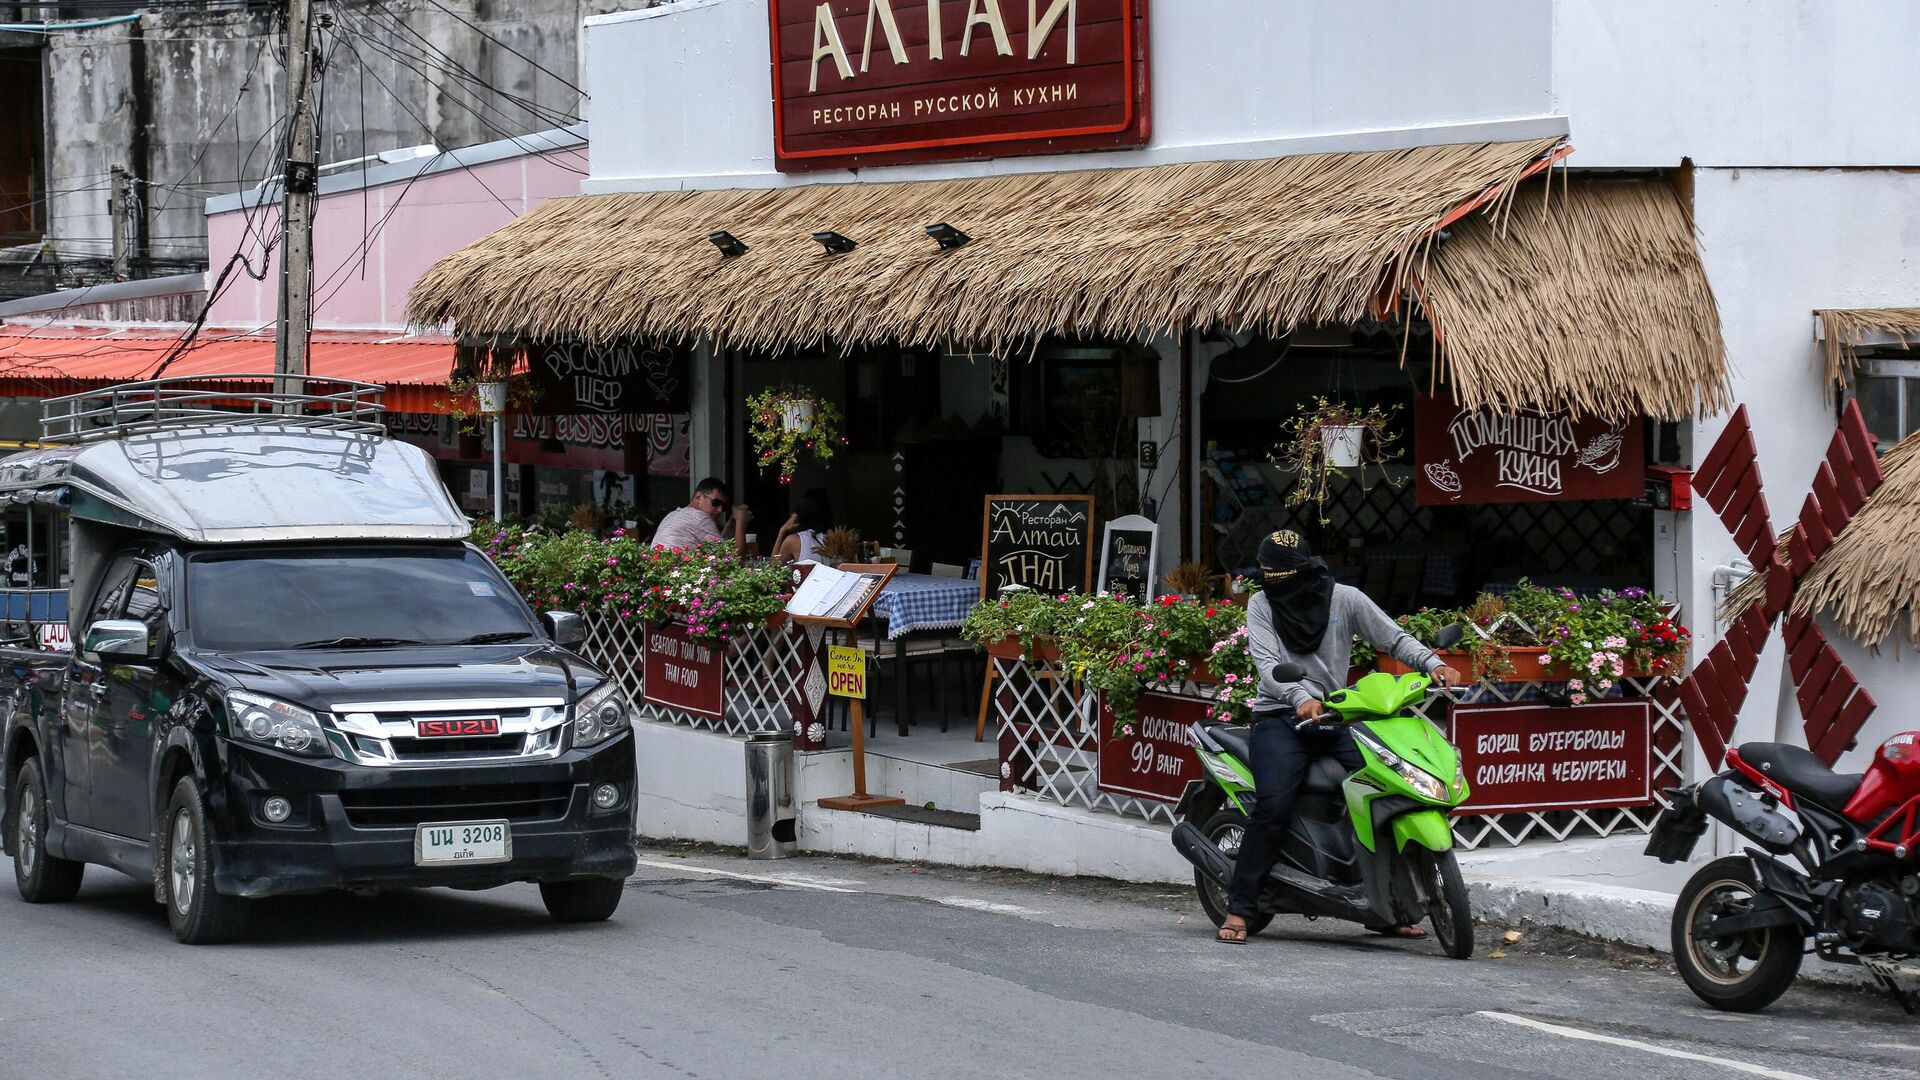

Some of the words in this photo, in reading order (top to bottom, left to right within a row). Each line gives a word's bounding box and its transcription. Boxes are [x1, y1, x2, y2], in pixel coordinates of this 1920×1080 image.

[813, 103, 901, 125] РЕСТОРАН
[914, 87, 999, 116] РУССКОЙ
[1013, 83, 1078, 107] КУХНИ
[574, 375, 622, 407] ШЕФ
[1450, 411, 1579, 463] ДОМАШНЯЯ
[1495, 450, 1562, 490] КУХНЯ
[990, 516, 1080, 547] Алтай
[1022, 512, 1068, 528] Ресторан
[999, 555, 1064, 590] THAI
[650, 633, 679, 657] SEAFOOD
[680, 641, 695, 661] TOM
[830, 650, 852, 661] Come
[853, 652, 865, 663] In
[664, 662, 681, 684] THAI
[680, 667, 699, 688] FOOD
[830, 671, 863, 694] OPEN
[419, 719, 499, 736] ISUZU
[1477, 733, 1520, 754] БОРЩ
[1529, 729, 1626, 753] БУТЕРБРОДЫ
[1131, 741, 1154, 774] 99
[1156, 753, 1184, 776] BAHT
[1476, 762, 1546, 785] СОЛЯНКА
[1552, 759, 1627, 782] ЧЕБУРЕКИ
[430, 829, 453, 846] บน
[463, 826, 503, 844] 3208
